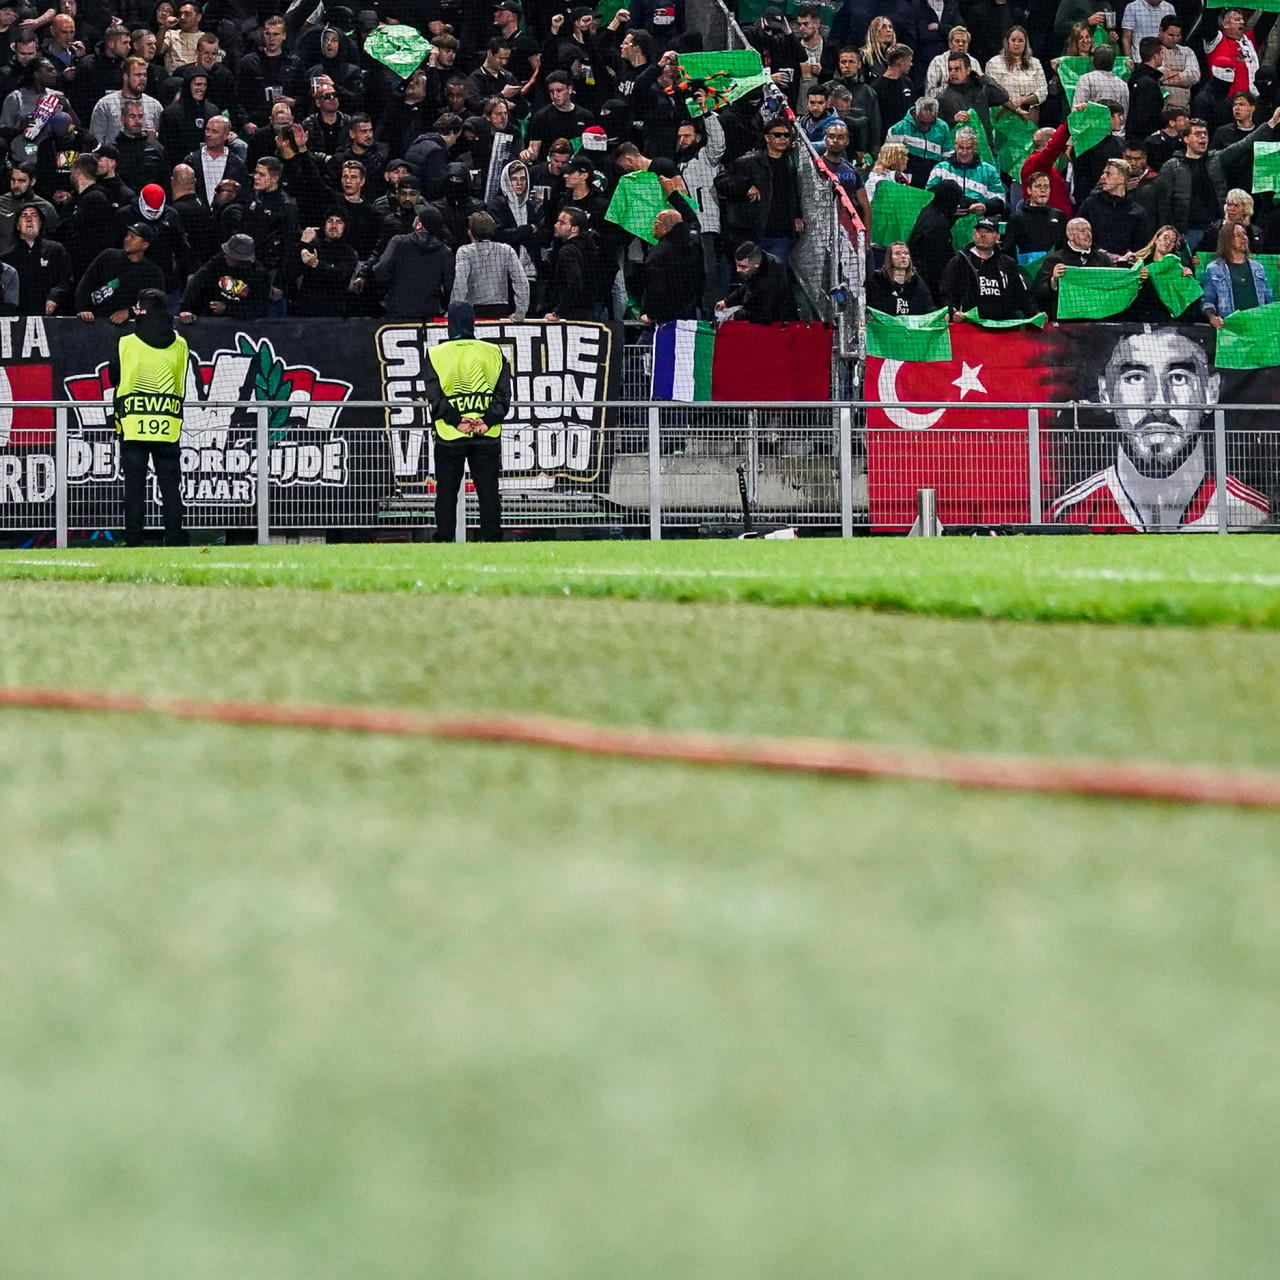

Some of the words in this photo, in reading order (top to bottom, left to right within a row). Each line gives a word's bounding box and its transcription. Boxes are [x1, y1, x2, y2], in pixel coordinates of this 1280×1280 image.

[381, 324, 600, 378] STIE
[387, 374, 597, 426] SION
[137, 419, 170, 435] 192
[185, 479, 250, 500] JAAR
